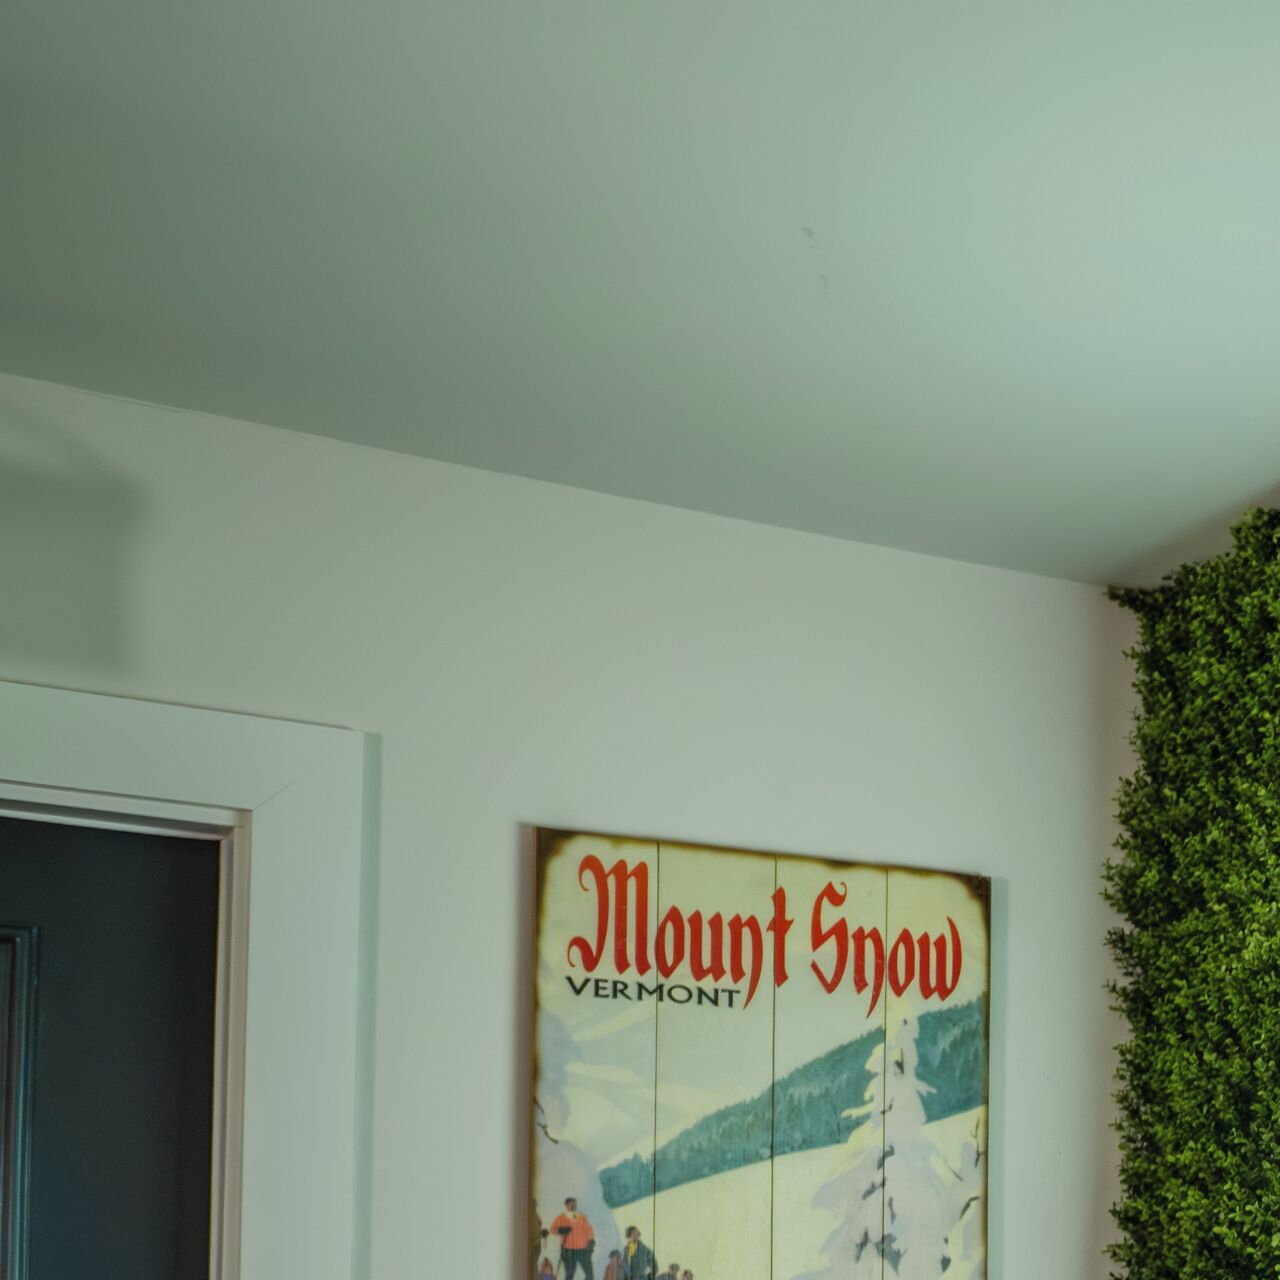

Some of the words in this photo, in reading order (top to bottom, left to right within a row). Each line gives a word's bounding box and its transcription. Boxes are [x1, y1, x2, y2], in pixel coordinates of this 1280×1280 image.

[567, 854, 794, 1010] Mount
[810, 881, 963, 1019] Snow
[565, 975, 741, 1009] VERMONT
